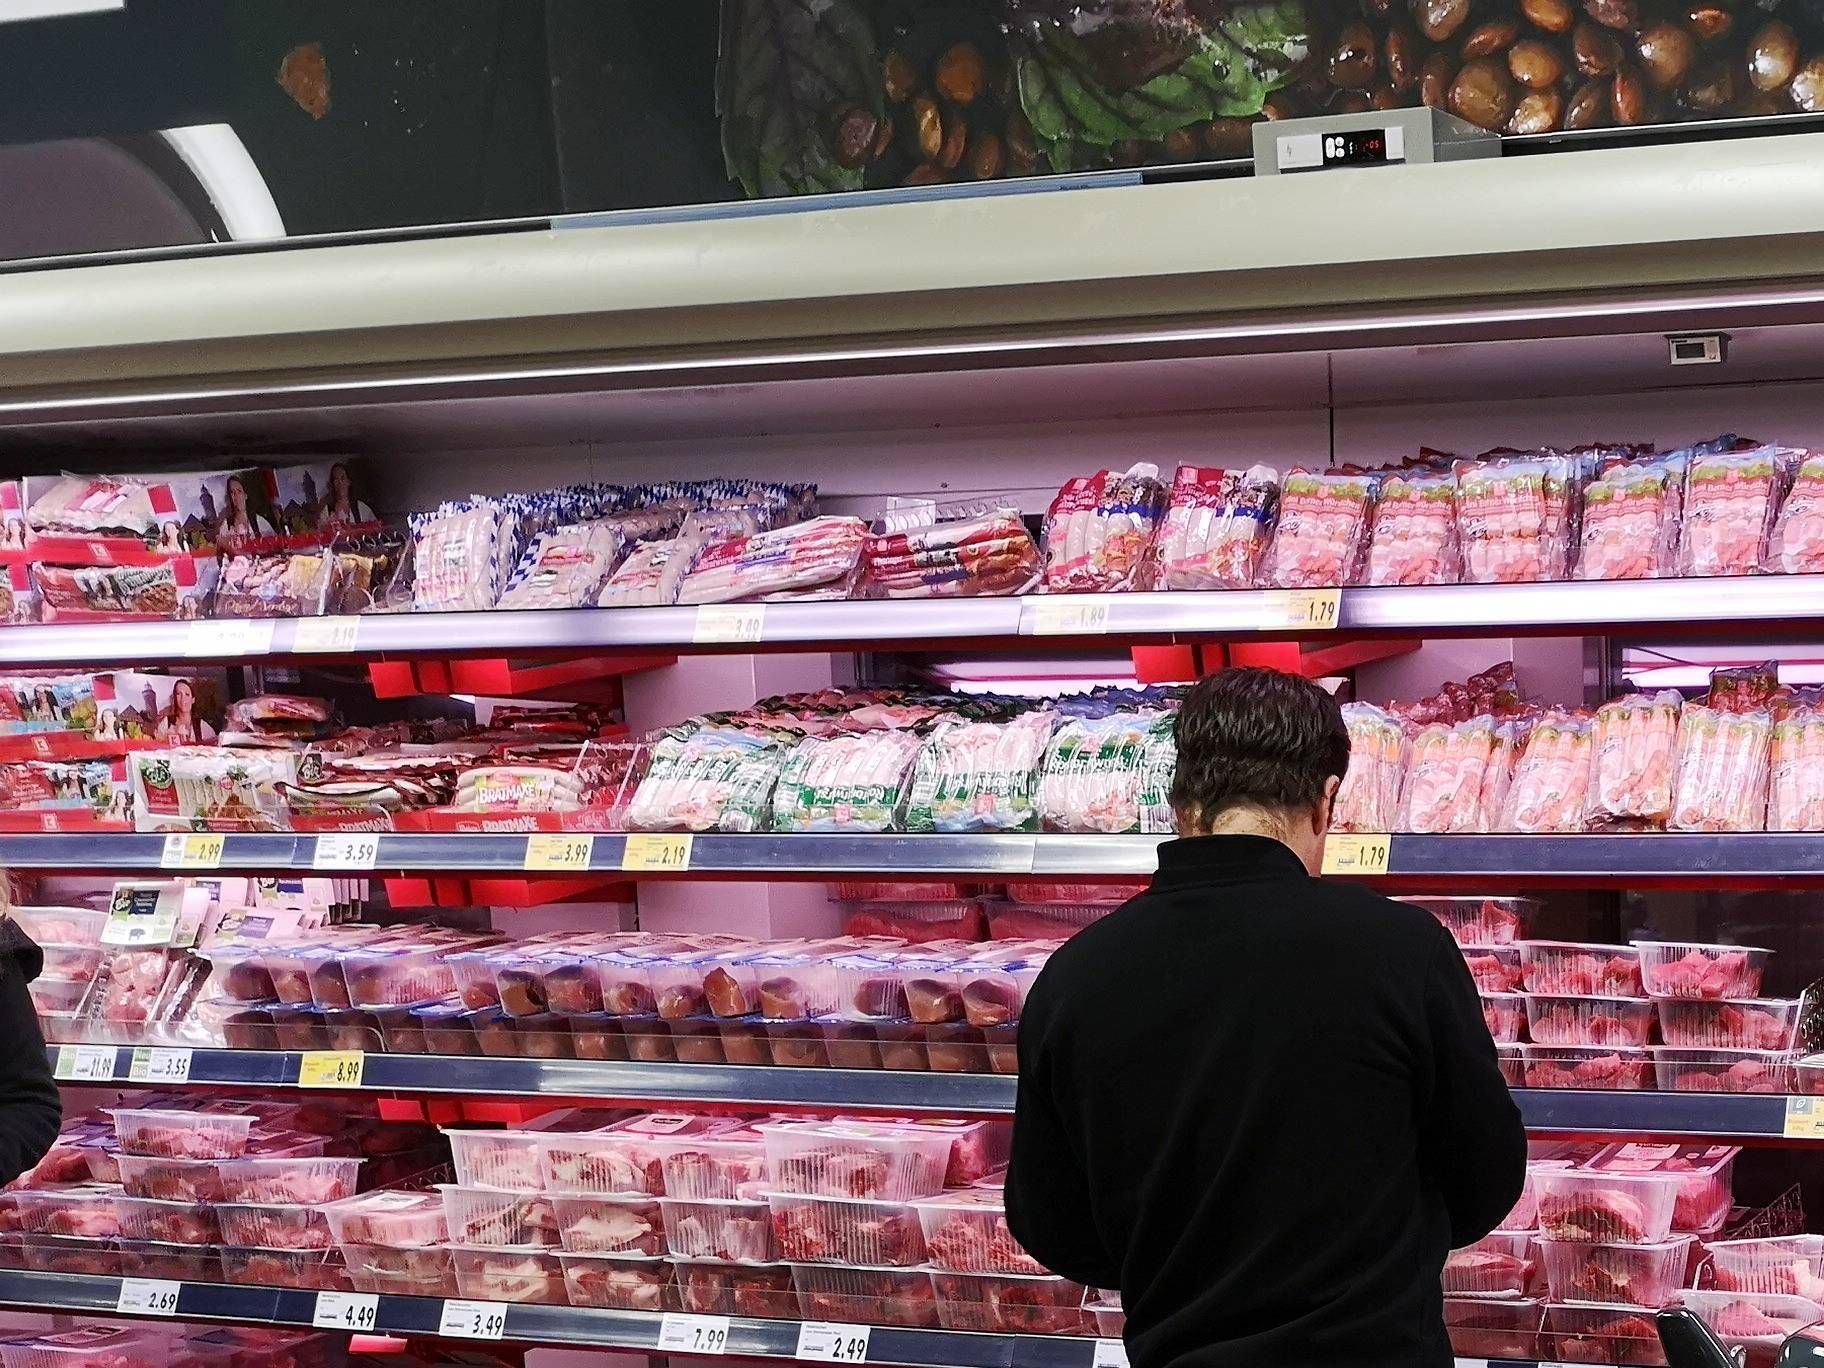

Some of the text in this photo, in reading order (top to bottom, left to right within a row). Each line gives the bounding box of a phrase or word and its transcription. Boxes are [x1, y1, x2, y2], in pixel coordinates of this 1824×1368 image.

[1309, 600, 1335, 622] 1.79
[478, 783, 537, 803] BRATMAXE
[198, 843, 221, 861] 2.99
[344, 843, 375, 861] 3.59
[563, 844, 589, 863] 3.99
[662, 845, 686, 864] 2.19
[1358, 846, 1386, 867] 1.79
[164, 1060, 187, 1077] 3.55
[336, 1061, 360, 1082] 8.99
[147, 1292, 178, 1311] 2.69
[344, 1304, 375, 1328] 4.49
[472, 1313, 503, 1338] 3.49
[692, 1327, 725, 1352] 7.99
[832, 1336, 867, 1362] 2.49
